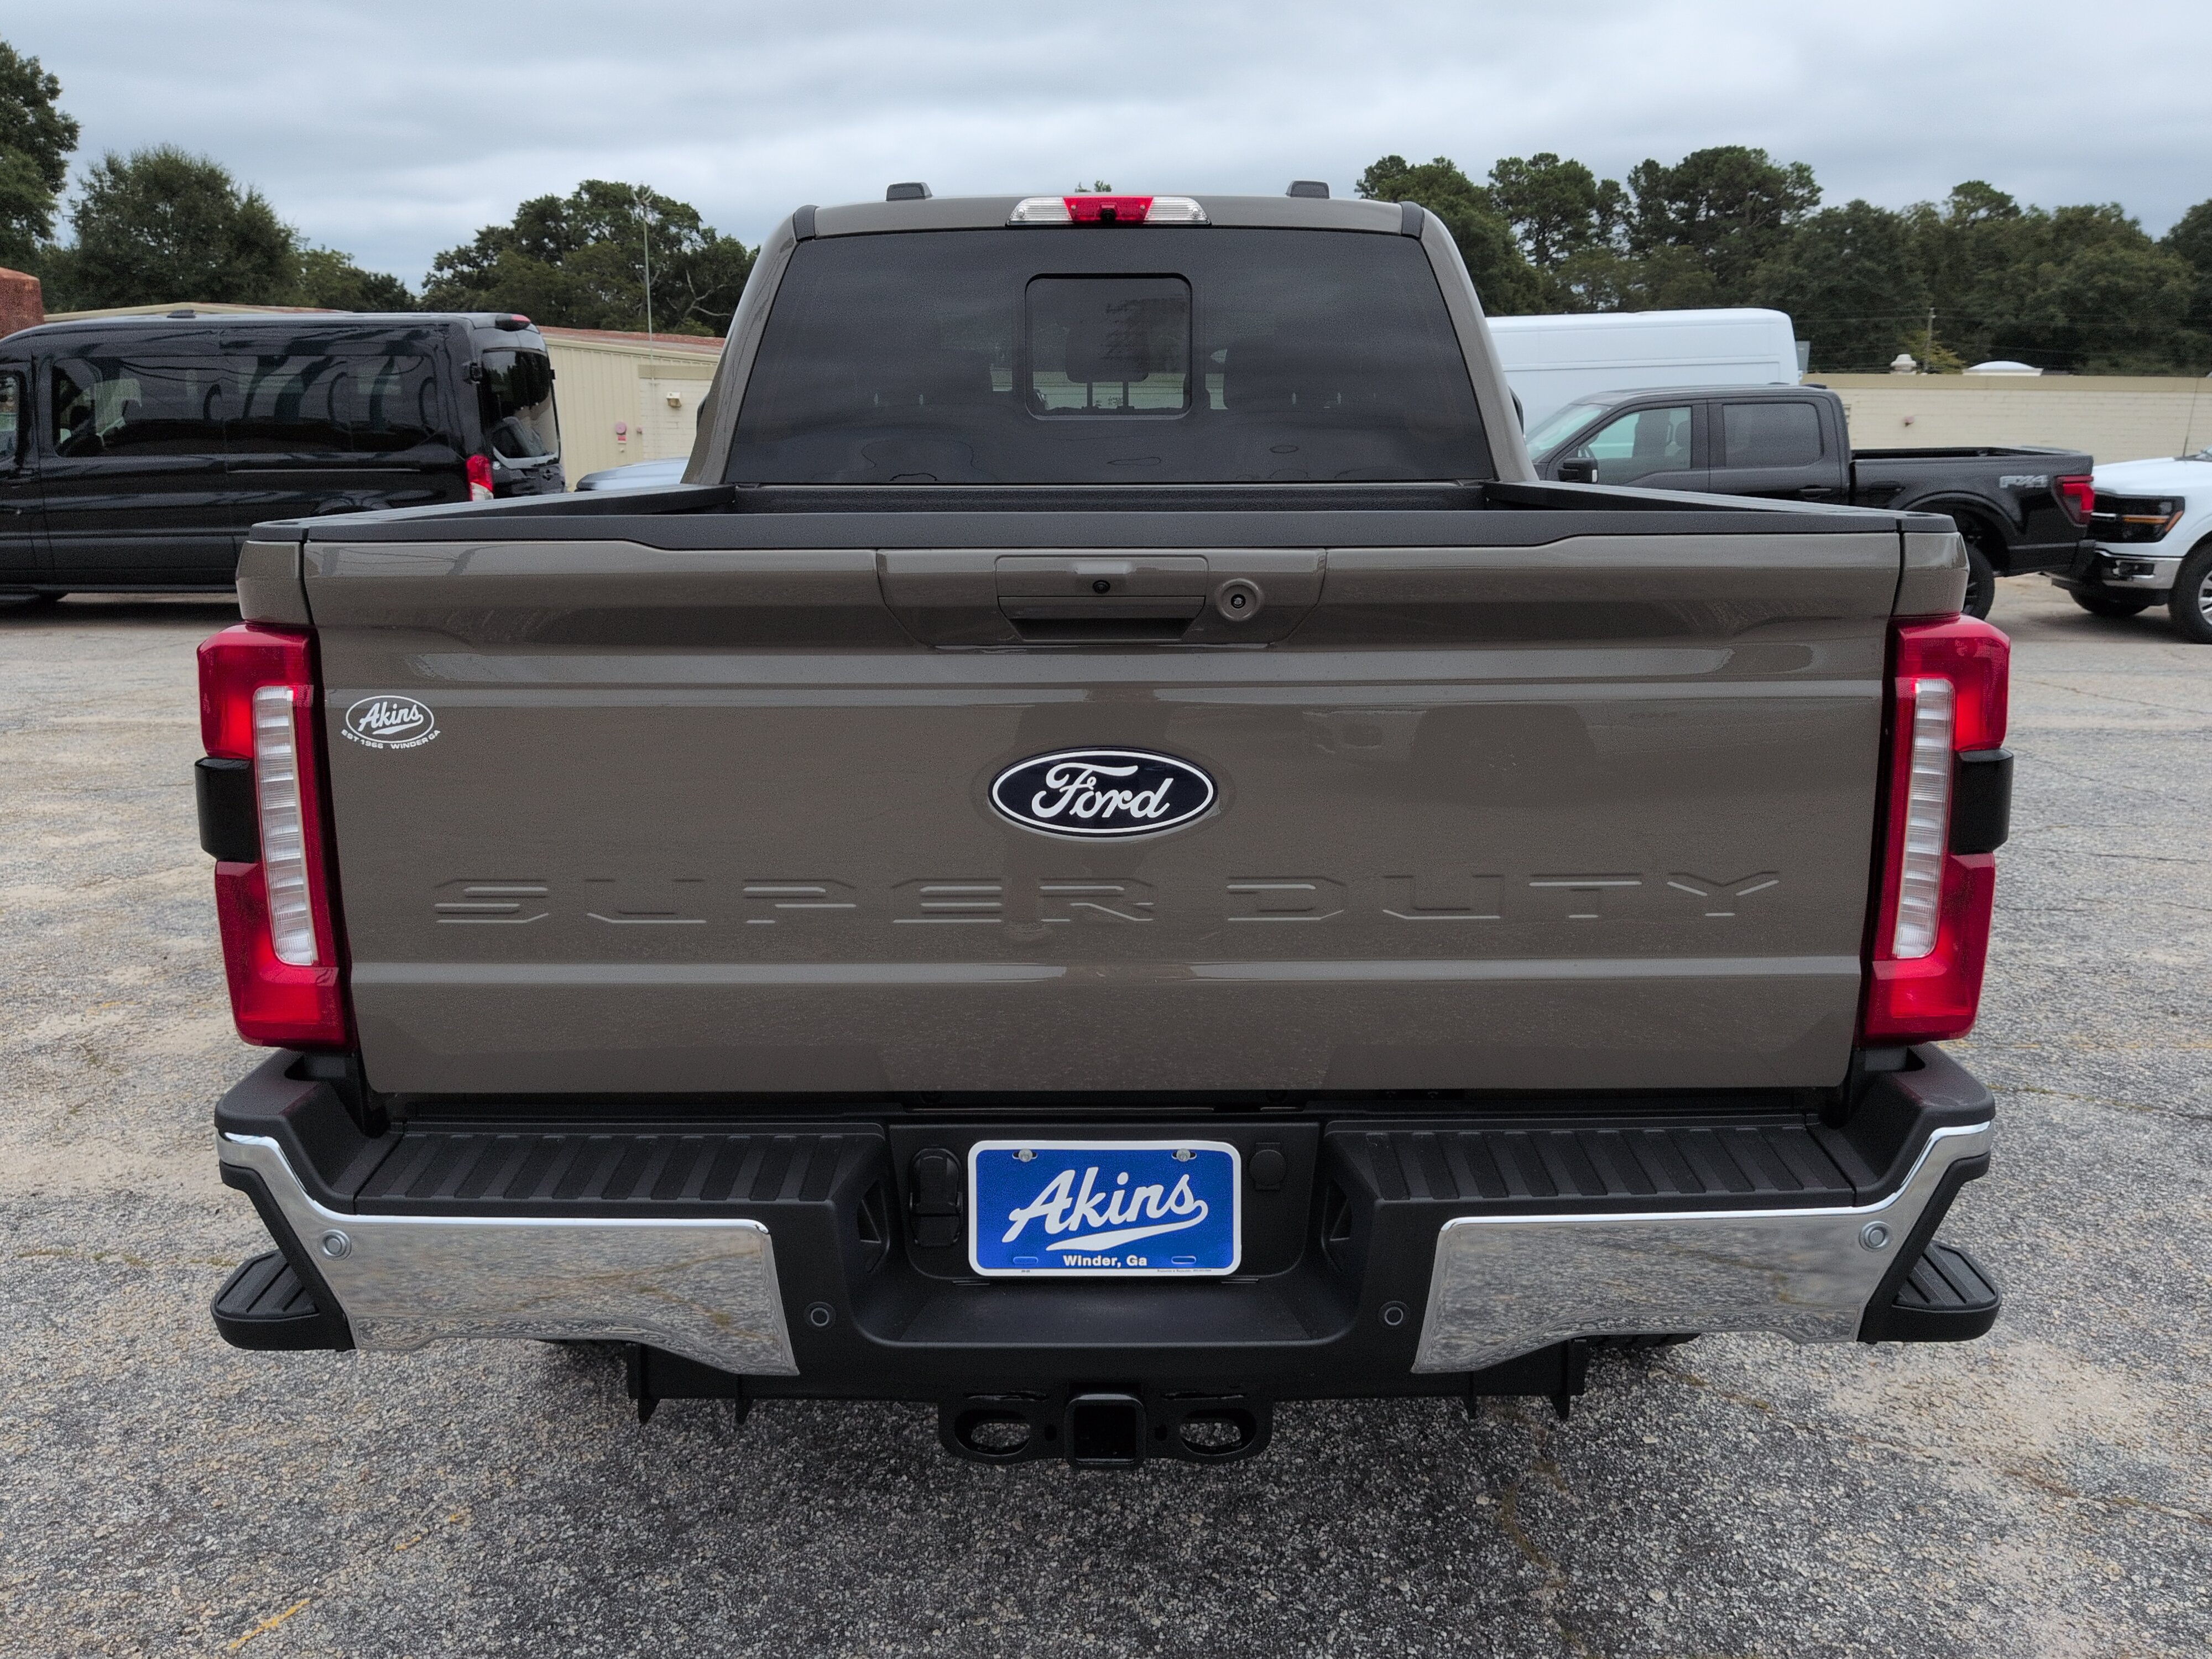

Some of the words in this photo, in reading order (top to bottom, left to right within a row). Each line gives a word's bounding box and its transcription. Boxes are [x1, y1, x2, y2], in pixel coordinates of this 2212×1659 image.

[1999, 474, 2049, 488] FX4
[358, 702, 424, 733] Akins
[341, 729, 359, 743] EST
[361, 739, 384, 749] 1966
[390, 738, 429, 749] WINDER
[429, 729, 441, 740] GA
[1031, 762, 1174, 818] Ford
[434, 878, 1155, 924] SUPER
[1226, 870, 1780, 921] DUTY
[1001, 1166, 1209, 1250] Akins
[1062, 1254, 1121, 1268] Winder,
[1126, 1254, 1147, 1267] Ga
